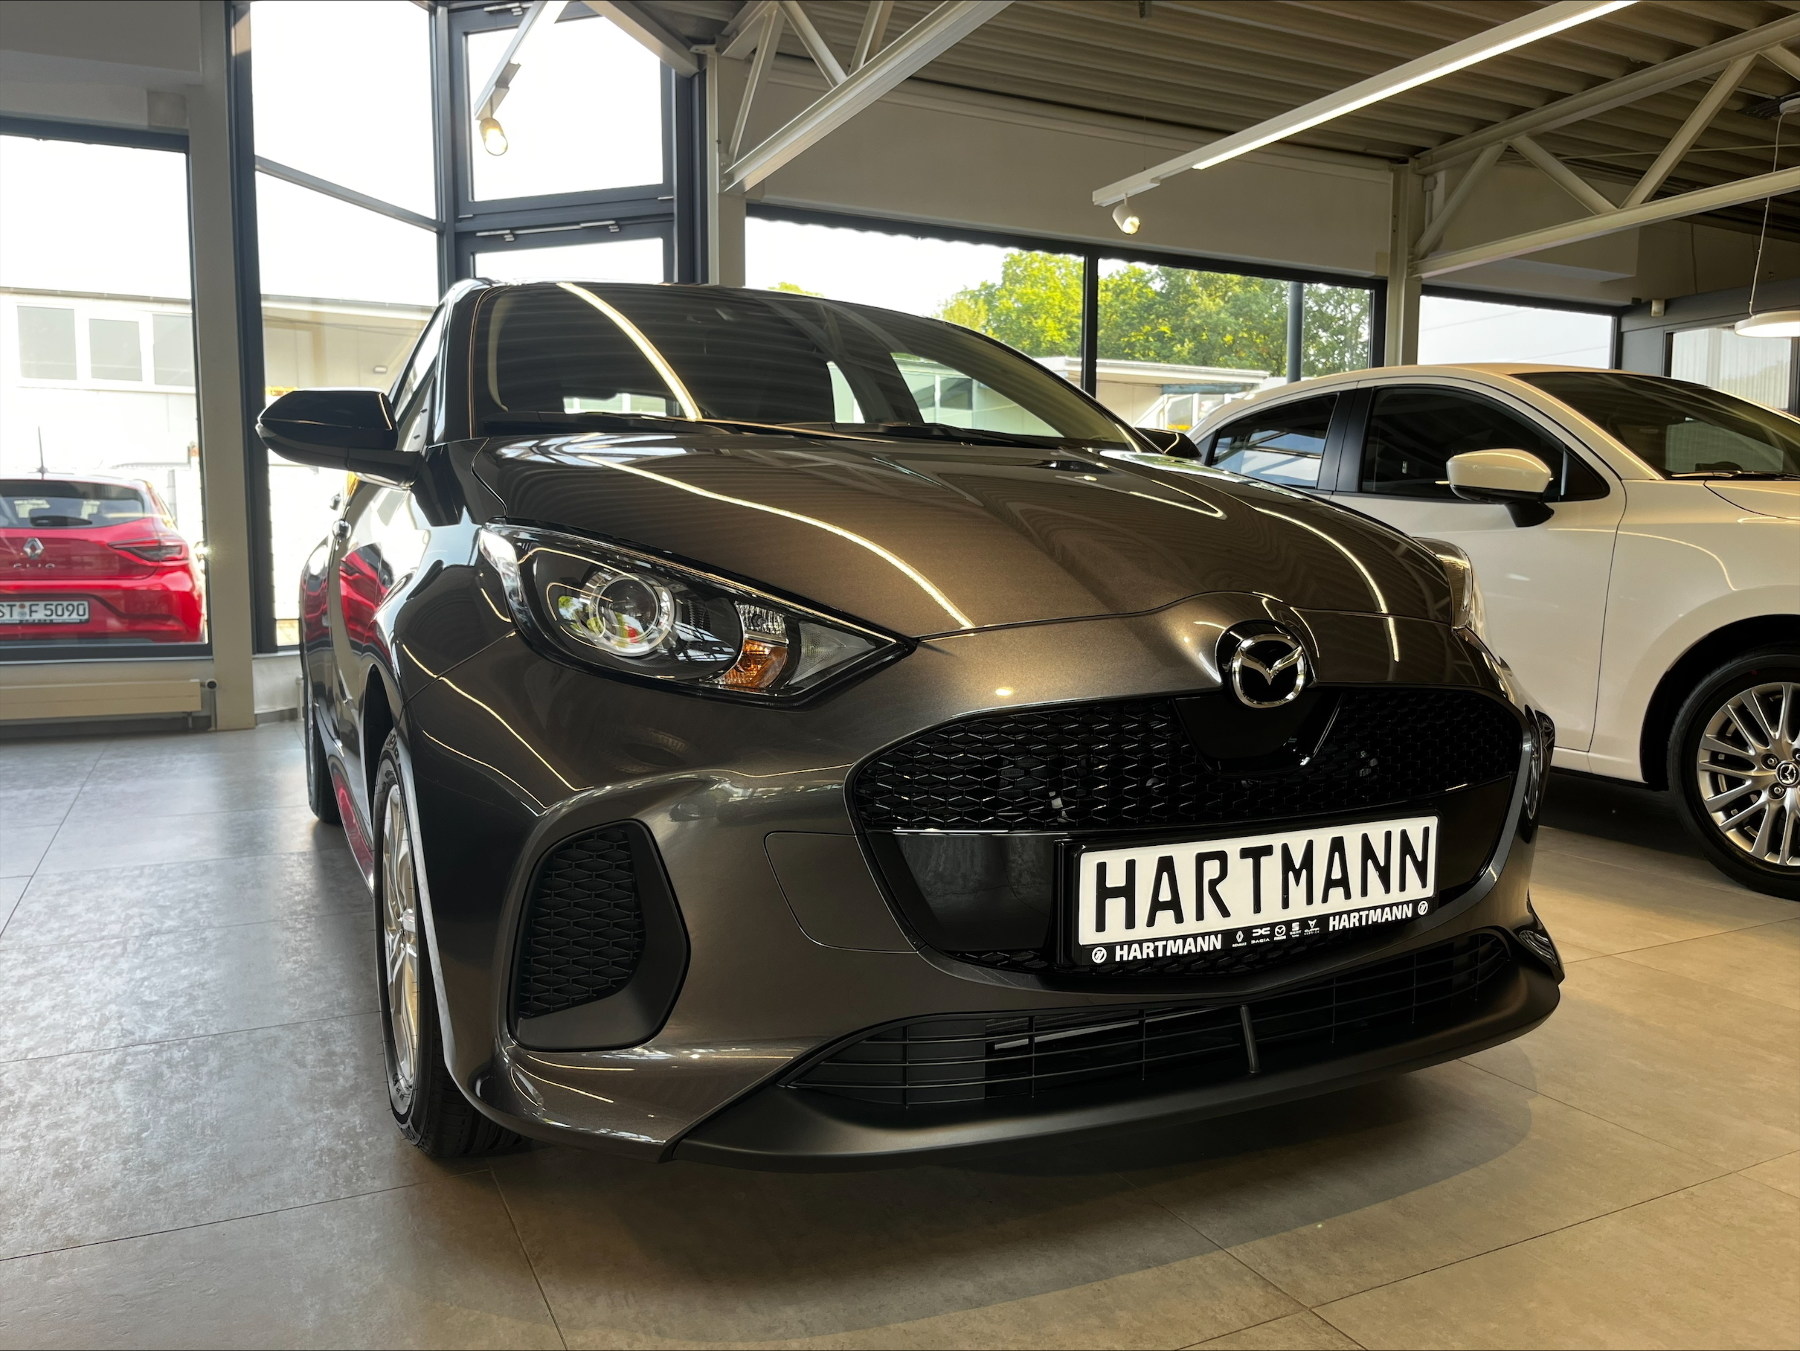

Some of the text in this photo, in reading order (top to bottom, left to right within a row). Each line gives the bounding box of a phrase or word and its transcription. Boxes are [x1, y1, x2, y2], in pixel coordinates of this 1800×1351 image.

[28, 603, 40, 618] F
[43, 603, 87, 617] 5090
[1095, 826, 1430, 932] HARTMANN
[1328, 903, 1412, 931] HARTMANN
[1115, 934, 1222, 962] HARTMANN
